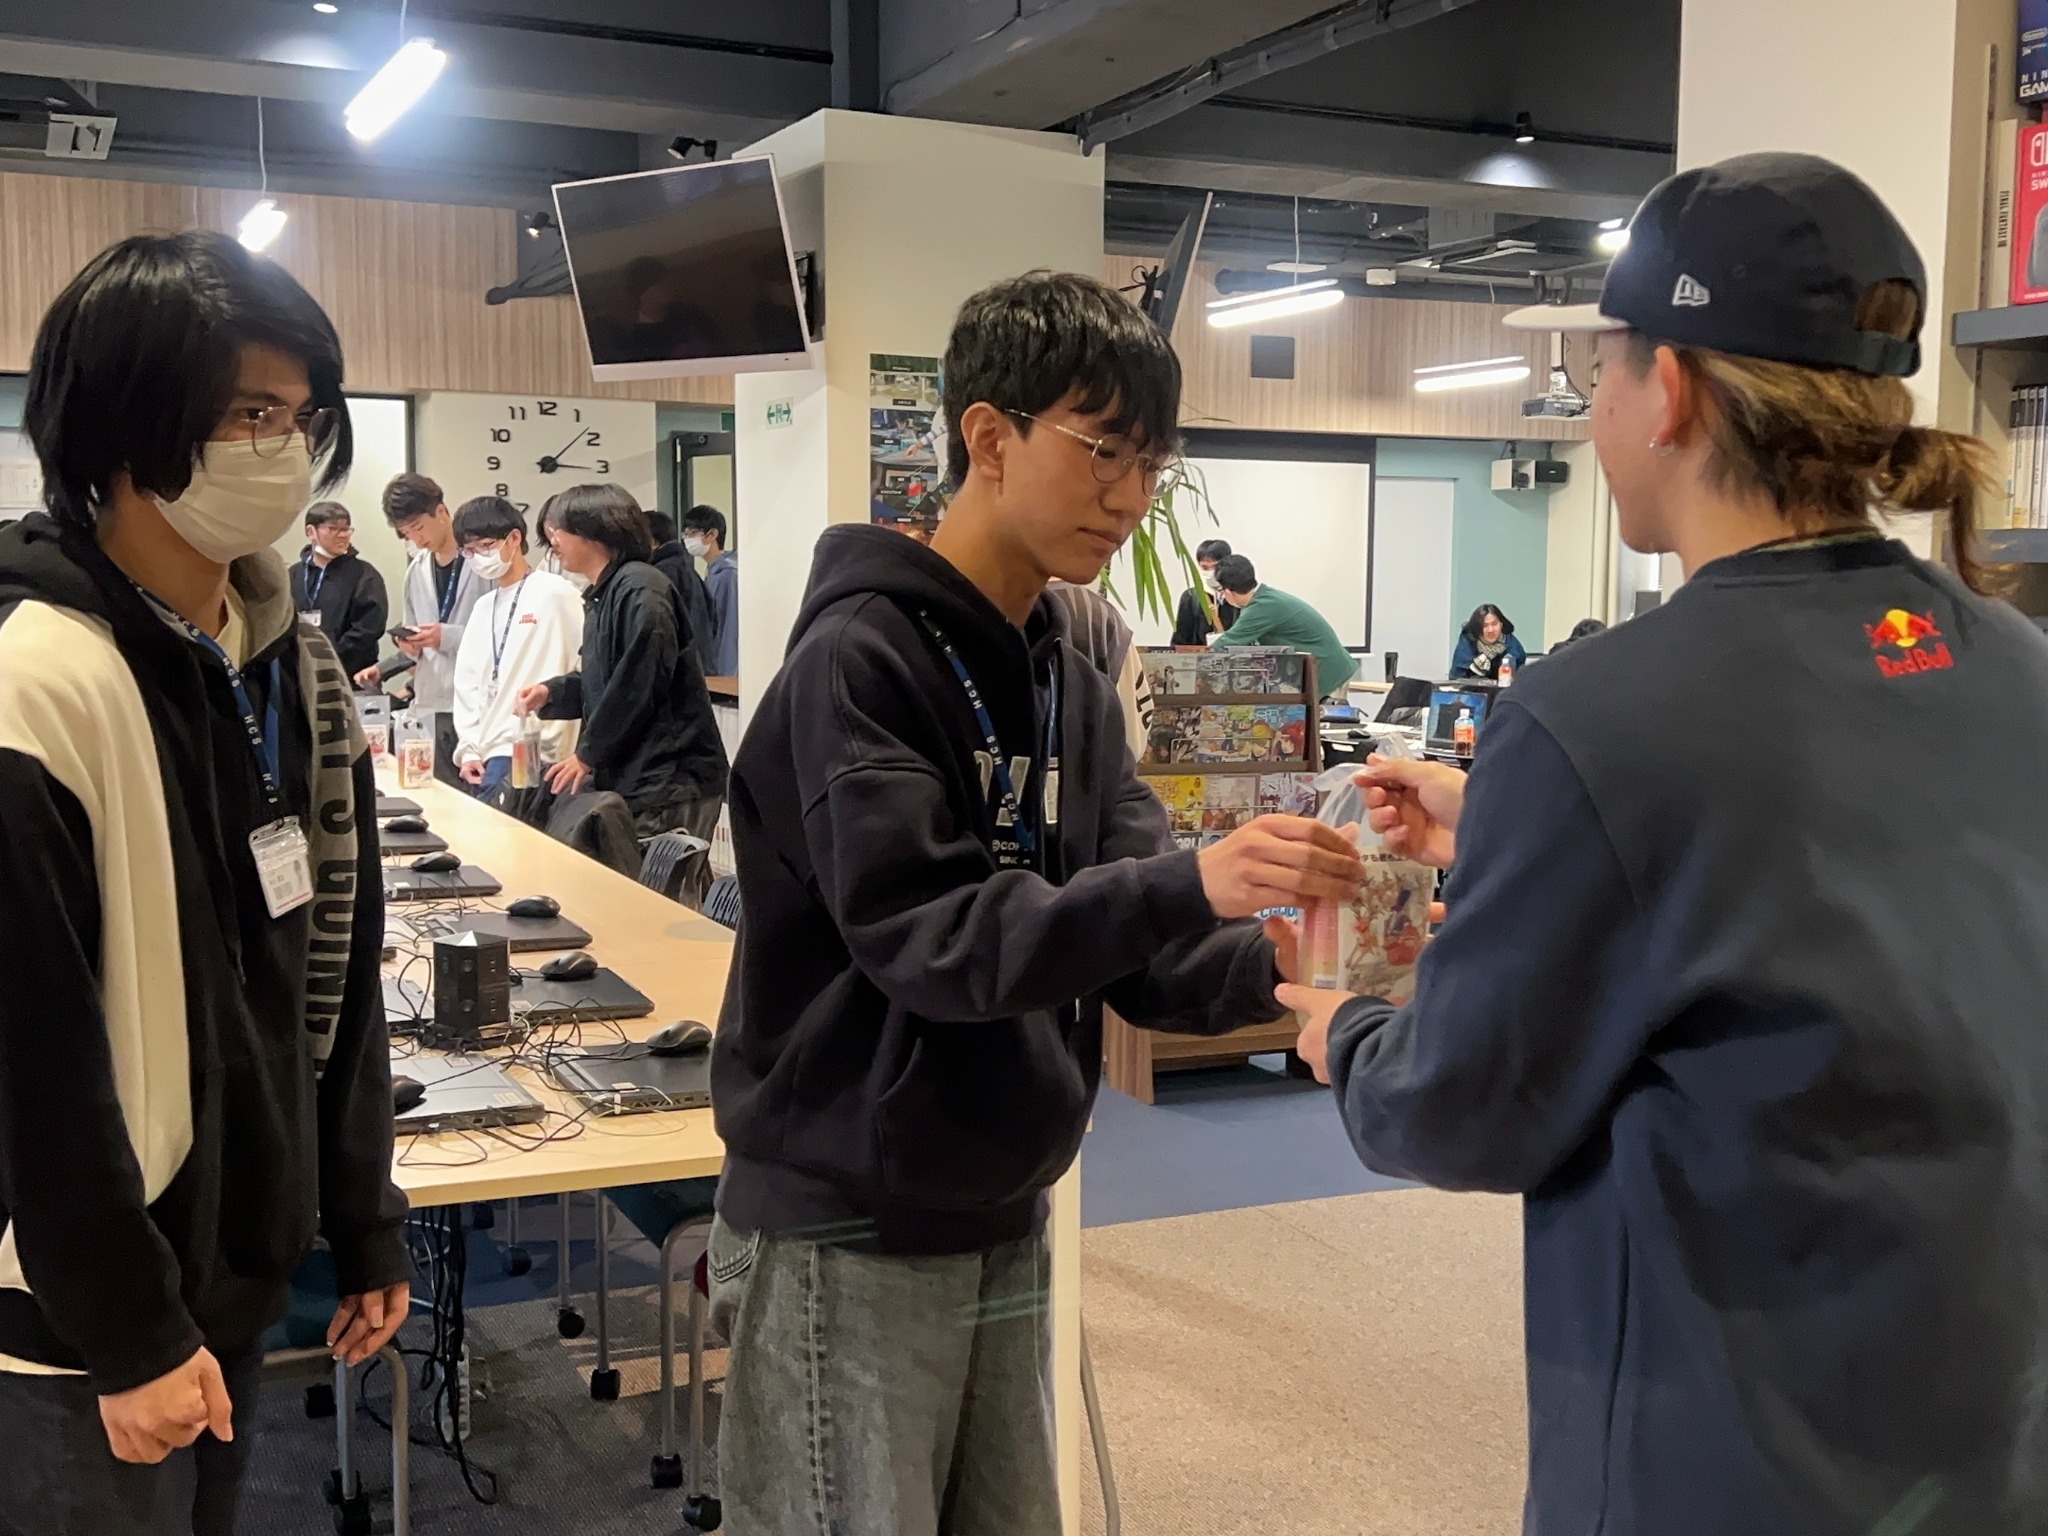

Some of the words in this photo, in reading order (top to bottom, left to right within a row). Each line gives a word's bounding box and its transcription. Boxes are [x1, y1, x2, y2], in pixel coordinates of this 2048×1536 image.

[509, 406, 526, 421] 11
[537, 401, 557, 416] 12
[573, 408, 580, 422] 1
[490, 428, 511, 443] 10
[586, 432, 601, 446] 2
[487, 456, 500, 470] 9
[596, 460, 609, 474] 3
[495, 483, 508, 497] 8
[963, 679, 982, 710] HCS
[243, 714, 262, 746] HCS
[986, 735, 1003, 765] HCS
